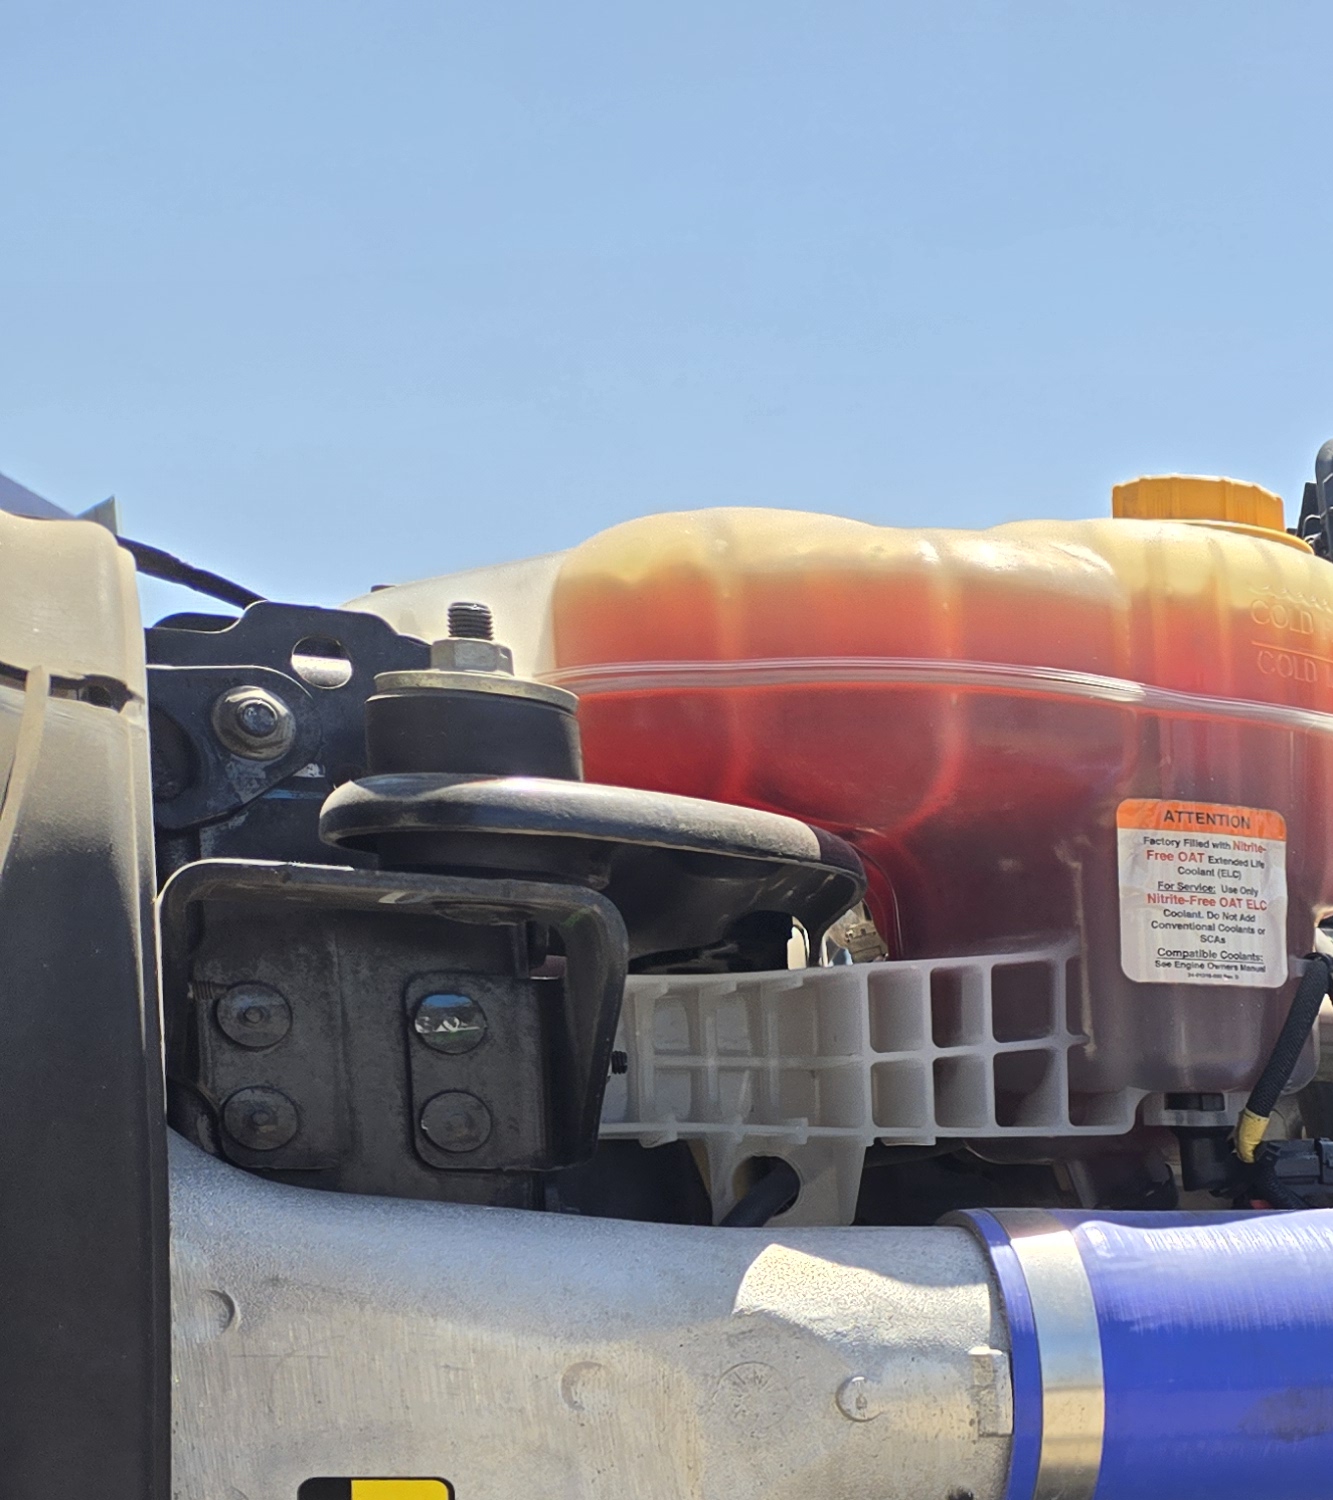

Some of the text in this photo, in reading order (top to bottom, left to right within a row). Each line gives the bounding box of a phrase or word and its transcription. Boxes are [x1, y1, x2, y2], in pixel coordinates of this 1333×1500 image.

[1258, 651, 1318, 682] COLD
[1164, 810, 1250, 829] ATTENTION
[1143, 836, 1181, 848] Factory
[1183, 838, 1209, 849] Filled
[1212, 840, 1231, 850] with
[1146, 850, 1265, 869] Free OAT Extended Life
[1177, 867, 1242, 880] Coolant (ELC)
[1158, 881, 1259, 897] For Service: Use Only
[1147, 893, 1267, 911] Nitrite-Free OAT ELC
[1163, 909, 1255, 923] Coolant. Do Not Add
[1151, 921, 1265, 935] Conventional Coolants or
[1200, 935, 1226, 944] SCAs
[1157, 947, 1263, 962] Compatible Coolants:
[1155, 960, 1266, 973] See Engine Owners Manual
